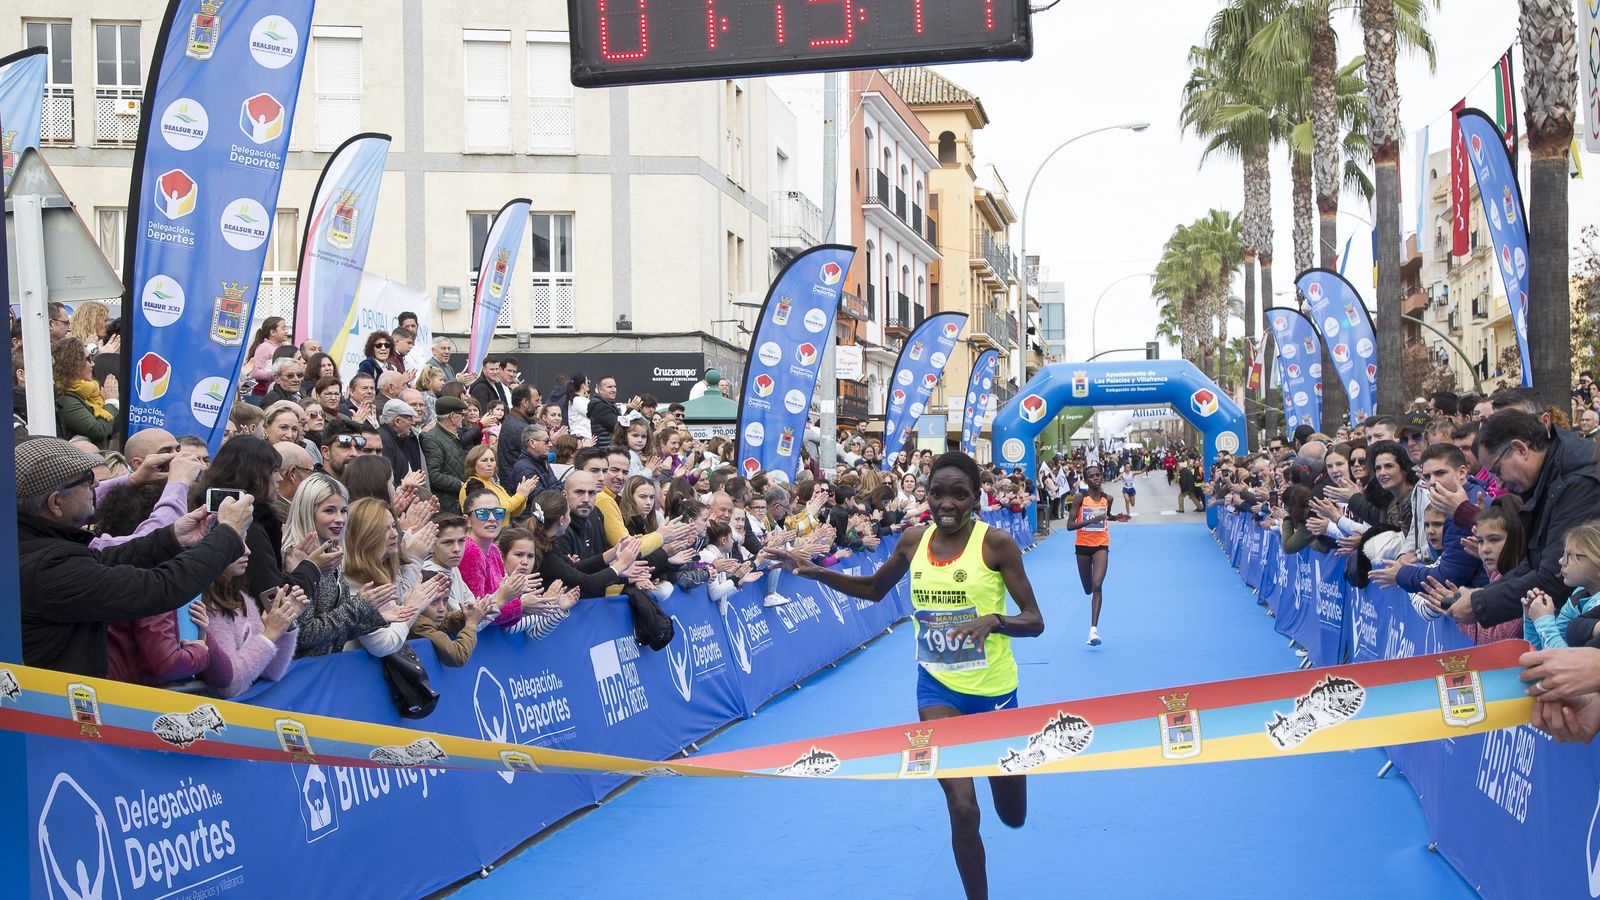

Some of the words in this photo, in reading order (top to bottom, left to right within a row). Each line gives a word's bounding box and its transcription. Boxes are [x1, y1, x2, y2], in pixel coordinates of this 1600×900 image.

[252, 41, 281, 52] BEALSUR
[281, 47, 293, 55] XXI
[164, 124, 191, 134] BEALSUR
[192, 128, 204, 136] XXI
[231, 144, 276, 160] Delegación
[230, 151, 281, 170] Deportes
[148, 220, 190, 236] Delegación
[223, 223, 252, 234] BEALSUR
[253, 229, 265, 237] XXI
[147, 228, 195, 245] Deportes
[653, 367, 697, 378] Cruzcampo
[1136, 376, 1169, 384] Villafranca
[193, 401, 222, 412] BEALSU
[1132, 407, 1168, 419] Allianz
[692, 639, 723, 669] Deportes
[508, 668, 558, 700] Delegación
[514, 694, 571, 735] Deportes
[1512, 727, 1536, 778] PACO
[114, 776, 213, 834] Delegación
[211, 789, 224, 807] de
[1504, 770, 1533, 825] REYES
[124, 817, 237, 890] Deportes
